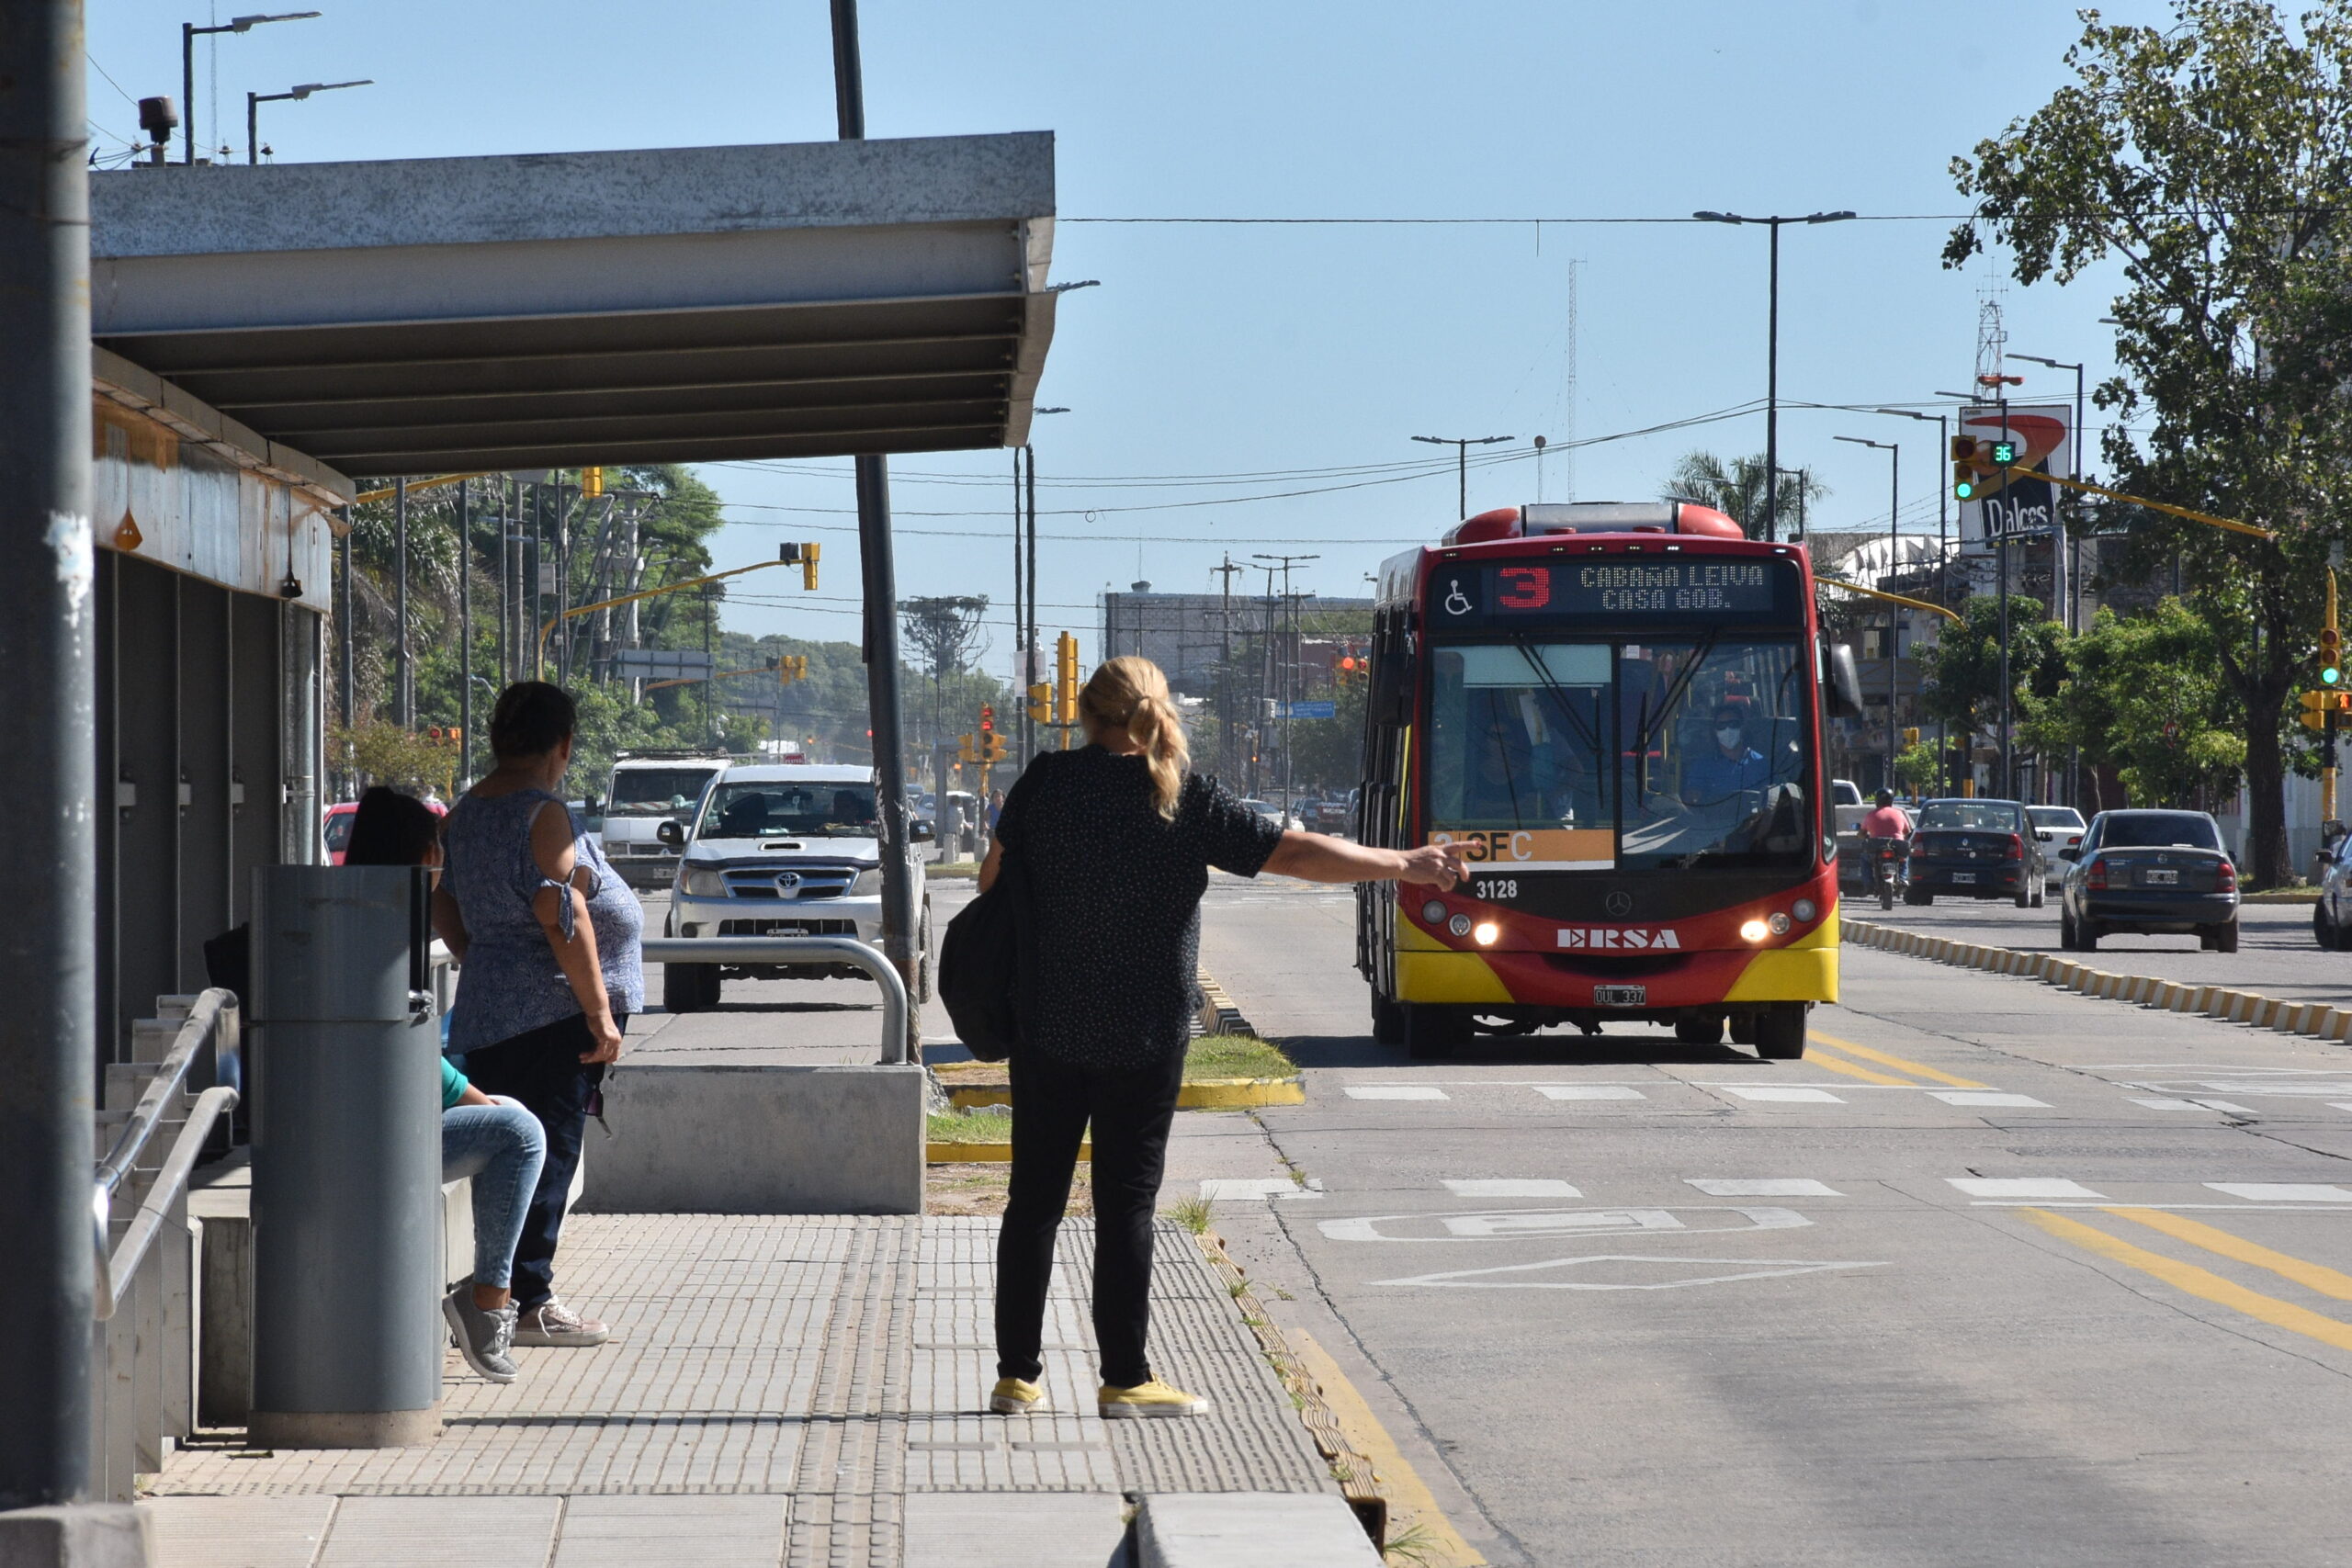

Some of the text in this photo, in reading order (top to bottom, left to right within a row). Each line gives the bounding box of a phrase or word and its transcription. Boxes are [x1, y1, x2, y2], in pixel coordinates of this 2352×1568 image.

[1996, 446, 2011, 461] 36
[1689, 565, 1764, 586] LEIVA
[1499, 567, 1551, 608] 3
[1602, 588, 1731, 610] CASA GOB.
[1476, 879, 1518, 898] 3128
[1557, 929, 1680, 948] ERSA
[1623, 990, 1644, 1003] 337
